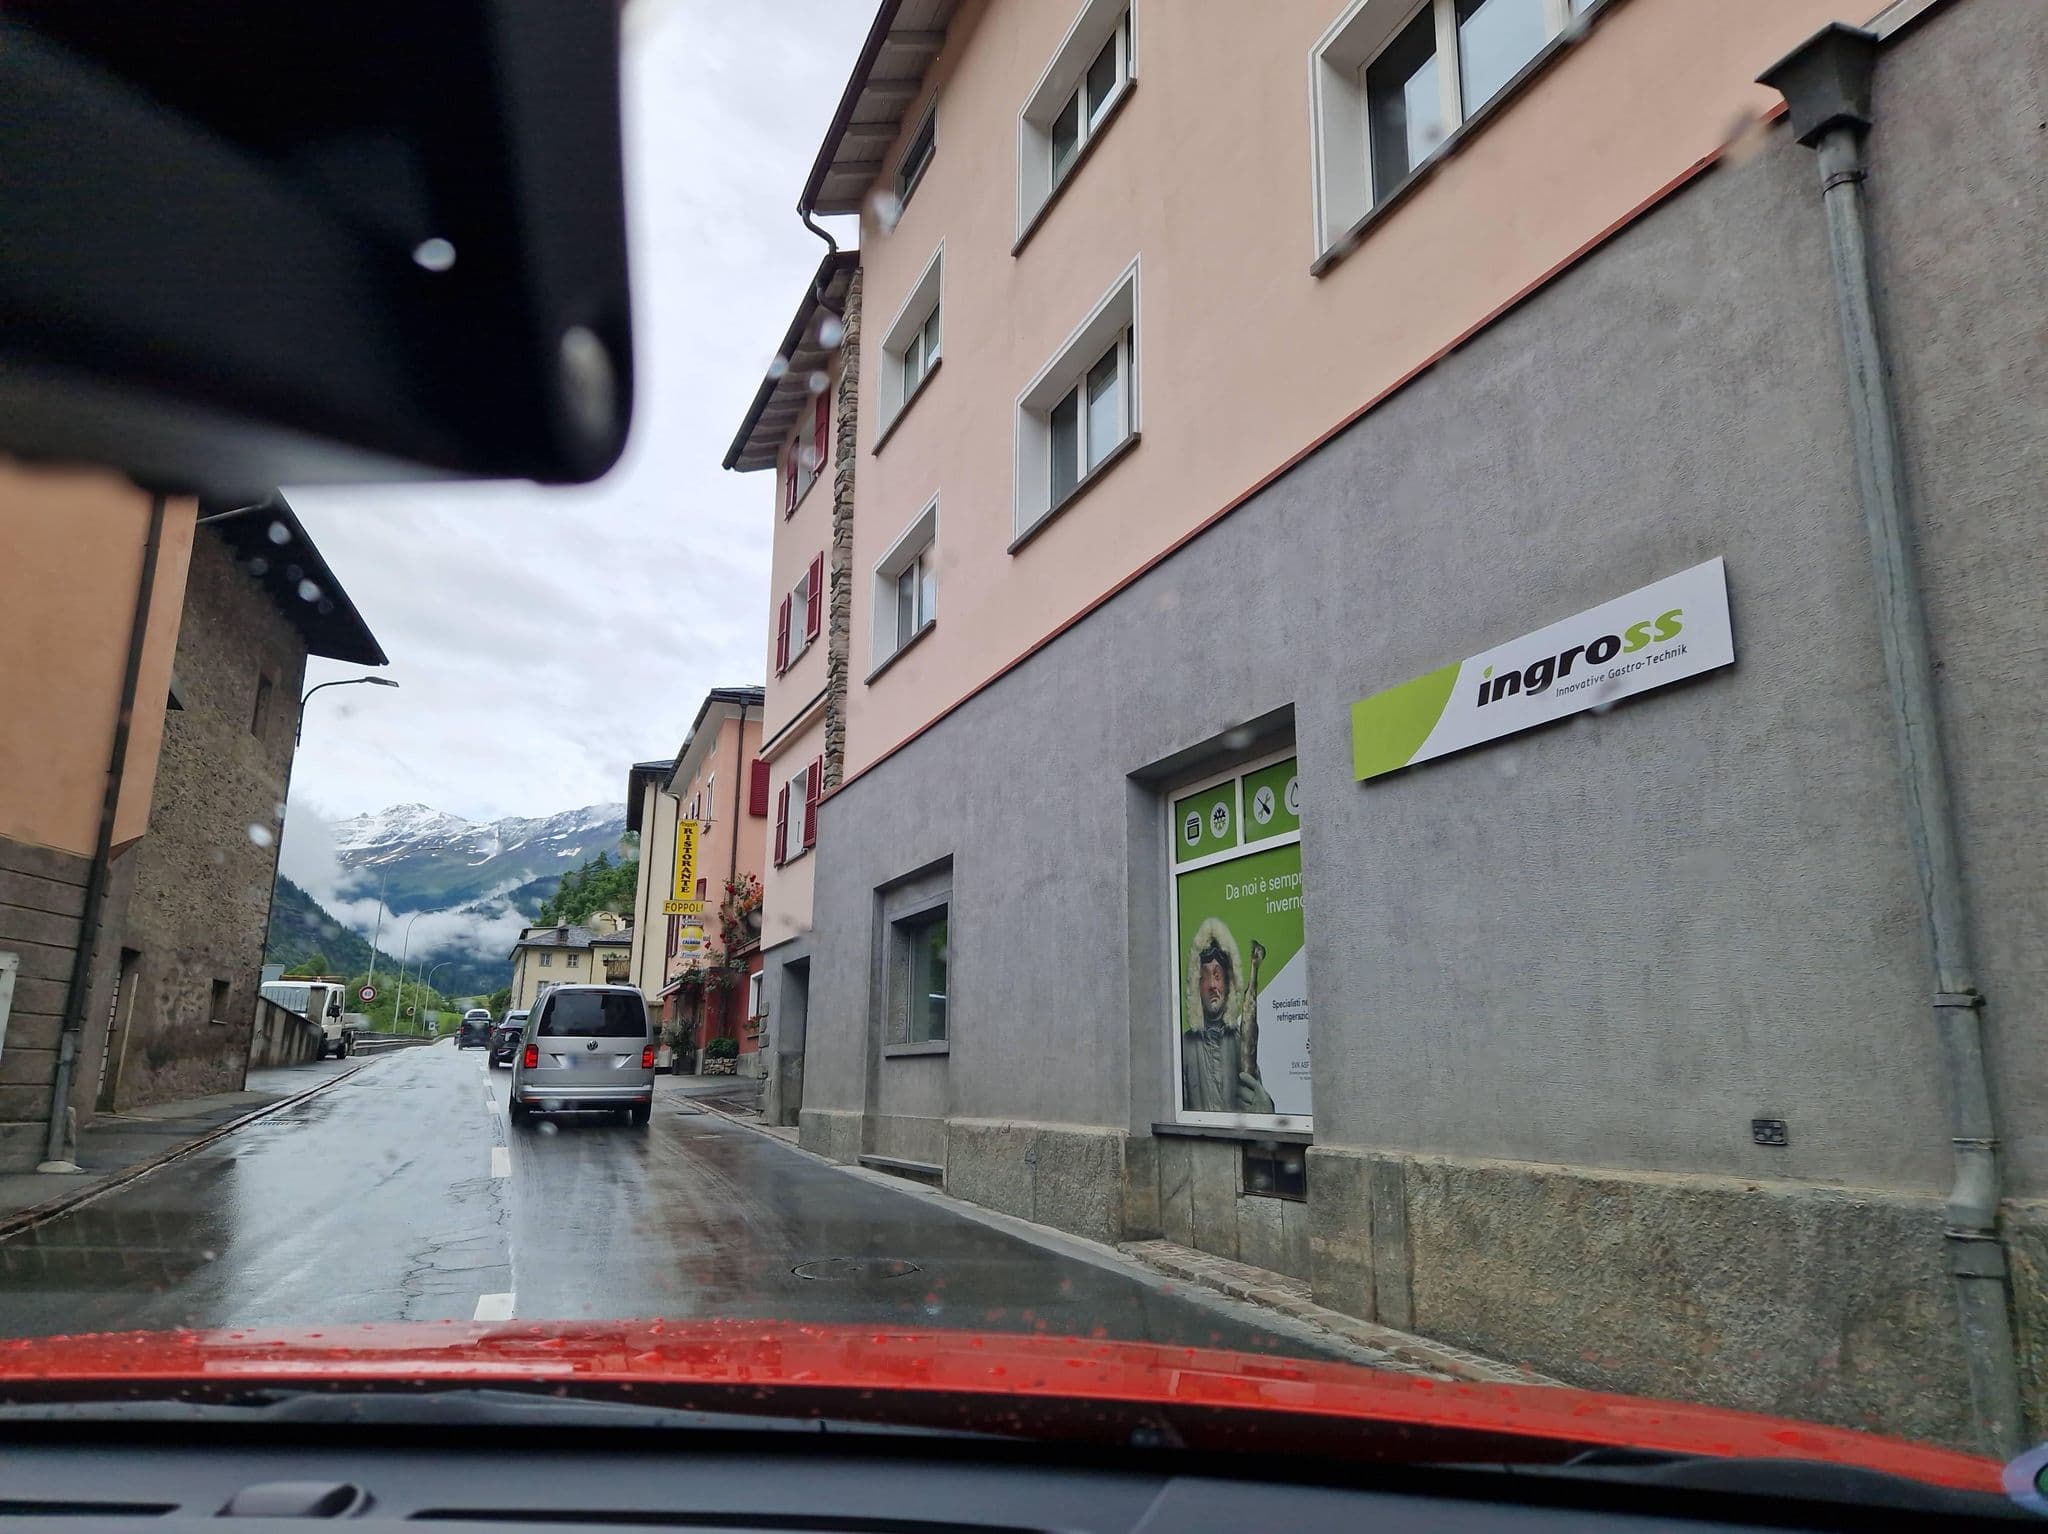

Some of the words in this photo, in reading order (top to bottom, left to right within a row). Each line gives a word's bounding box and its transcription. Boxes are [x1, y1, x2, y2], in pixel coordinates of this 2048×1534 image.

[1477, 608, 1683, 708] ingross
[1555, 673, 1606, 698] Innovative
[1607, 643, 1688, 680] Gastro-Technik
[680, 827, 693, 893] RISTORANTE
[665, 902, 704, 913] FOPPOLI
[1225, 884, 1240, 900] Da
[1241, 877, 1258, 897] noi
[1259, 876, 1267, 893] è
